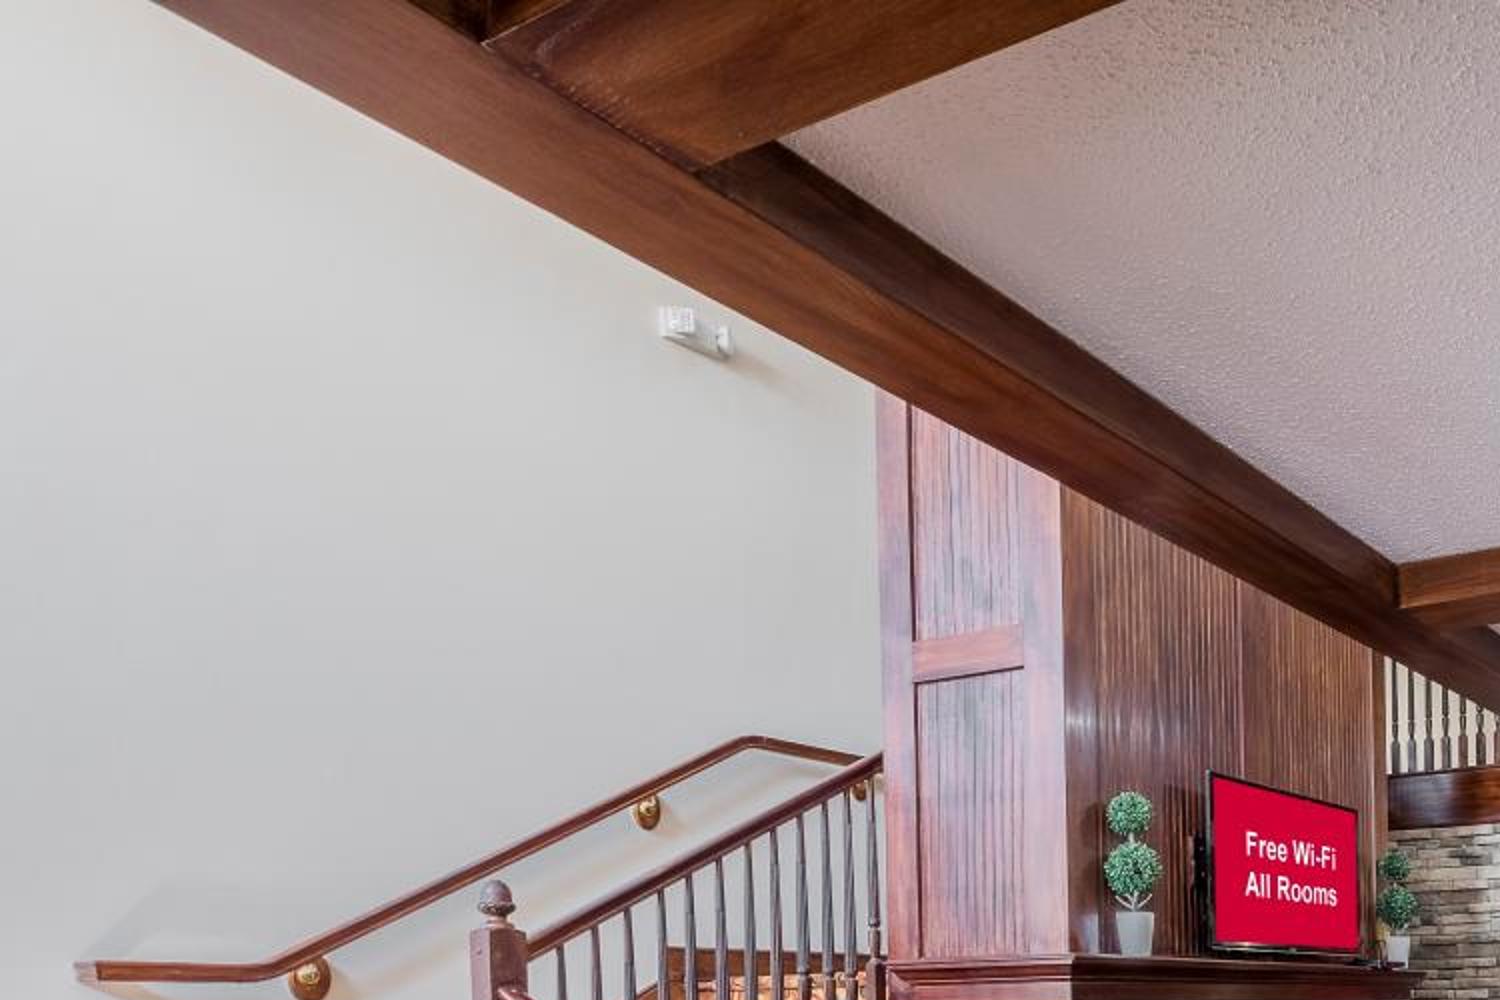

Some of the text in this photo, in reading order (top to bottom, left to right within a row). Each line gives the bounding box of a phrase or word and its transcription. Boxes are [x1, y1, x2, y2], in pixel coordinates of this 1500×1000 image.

[1245, 831, 1337, 871] Free Wi-Fi
[1245, 871, 1338, 908] All Rooms
